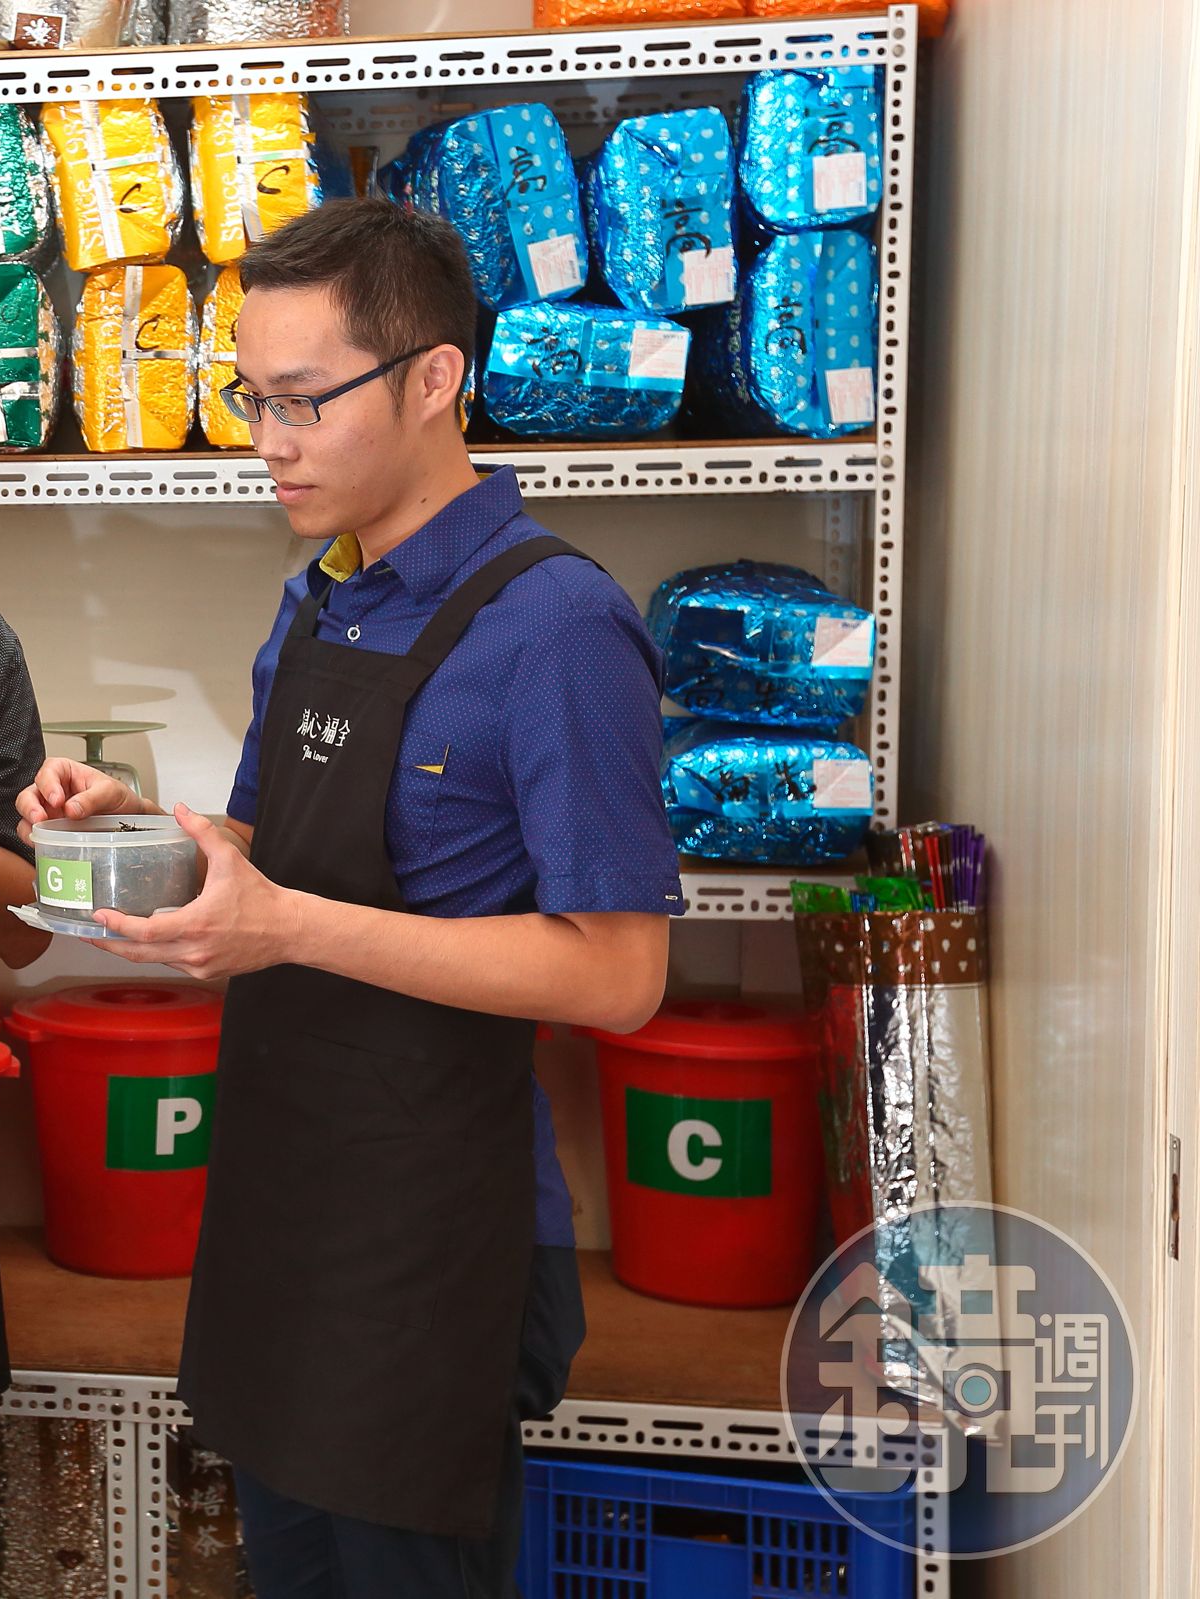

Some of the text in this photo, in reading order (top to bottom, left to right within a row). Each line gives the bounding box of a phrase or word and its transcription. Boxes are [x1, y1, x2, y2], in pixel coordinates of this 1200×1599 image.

[77, 178, 105, 250] Since
[221, 172, 244, 242] Since
[99, 289, 124, 433] Since 1987
[296, 708, 351, 747] 清心福全
[47, 866, 63, 892] G
[155, 1097, 203, 1155] P
[667, 1119, 723, 1181] C
